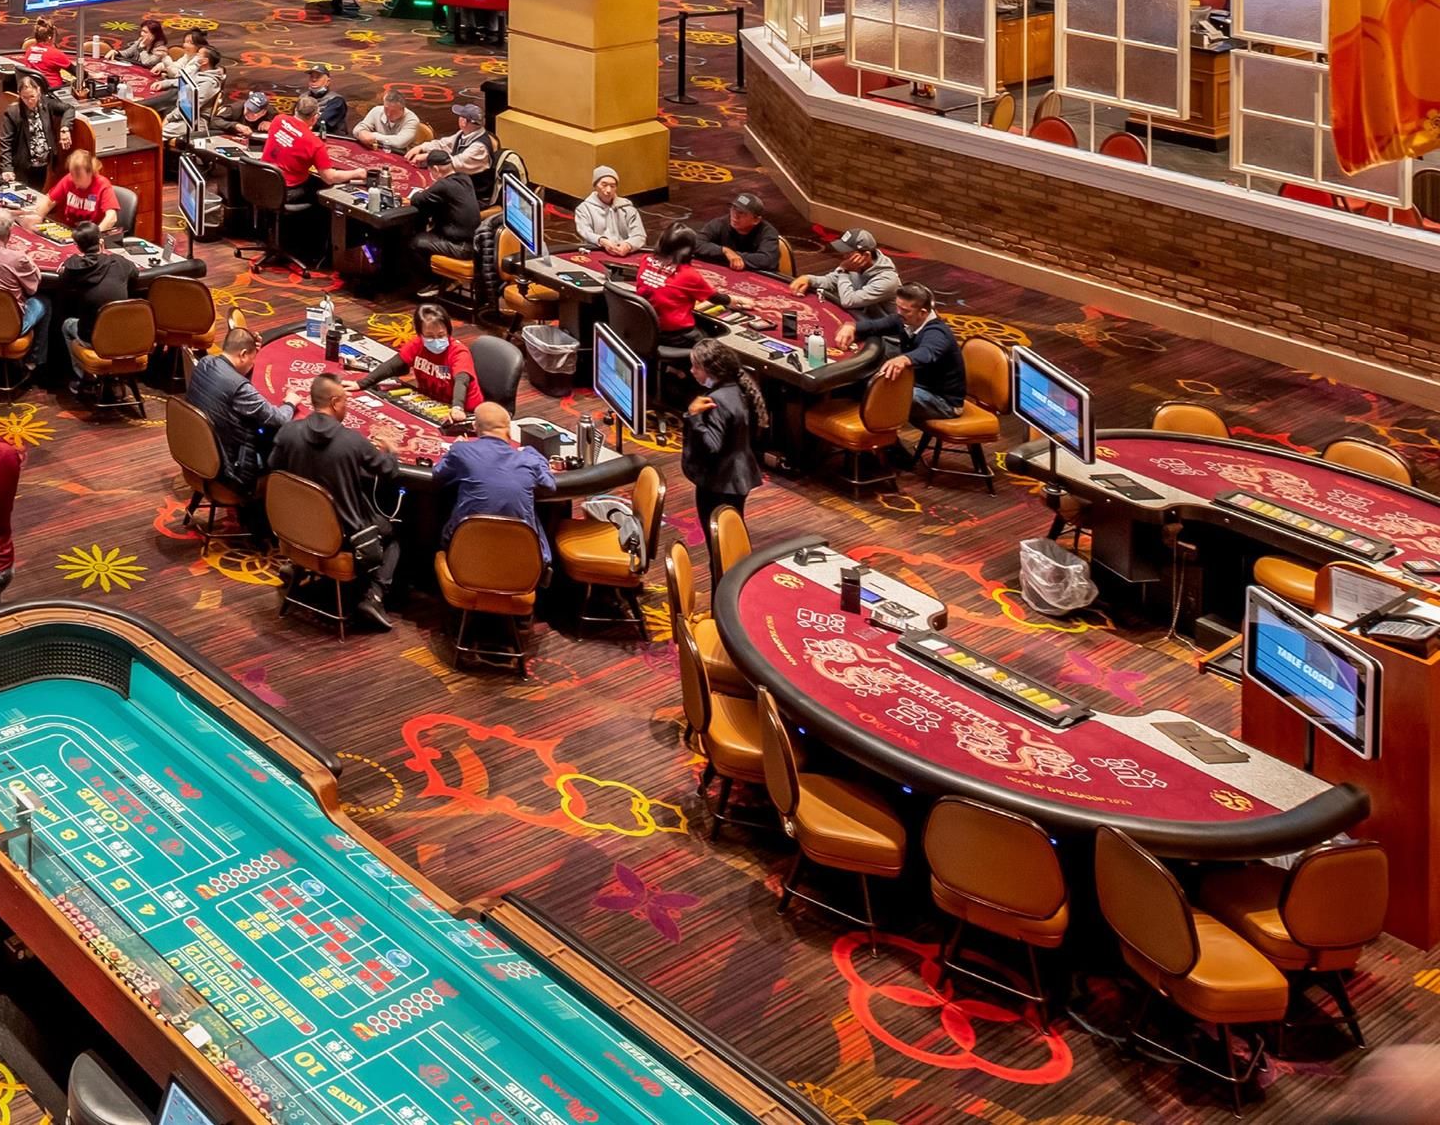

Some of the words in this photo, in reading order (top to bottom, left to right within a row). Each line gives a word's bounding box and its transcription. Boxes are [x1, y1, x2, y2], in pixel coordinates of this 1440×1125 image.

[1276, 646, 1302, 669] TABLE
[1302, 663, 1335, 691] CLOSED
[136, 773, 161, 792] LINE
[77, 787, 129, 832] COME
[159, 787, 186, 814] PASS
[60, 828, 79, 841] 8
[83, 851, 107, 868] SIX
[111, 877, 131, 892] 5
[138, 903, 157, 917] 4
[183, 944, 205, 963] 12
[294, 1051, 328, 1078] 10
[326, 1083, 369, 1114] NINE
[504, 1082, 538, 1113] LINE
